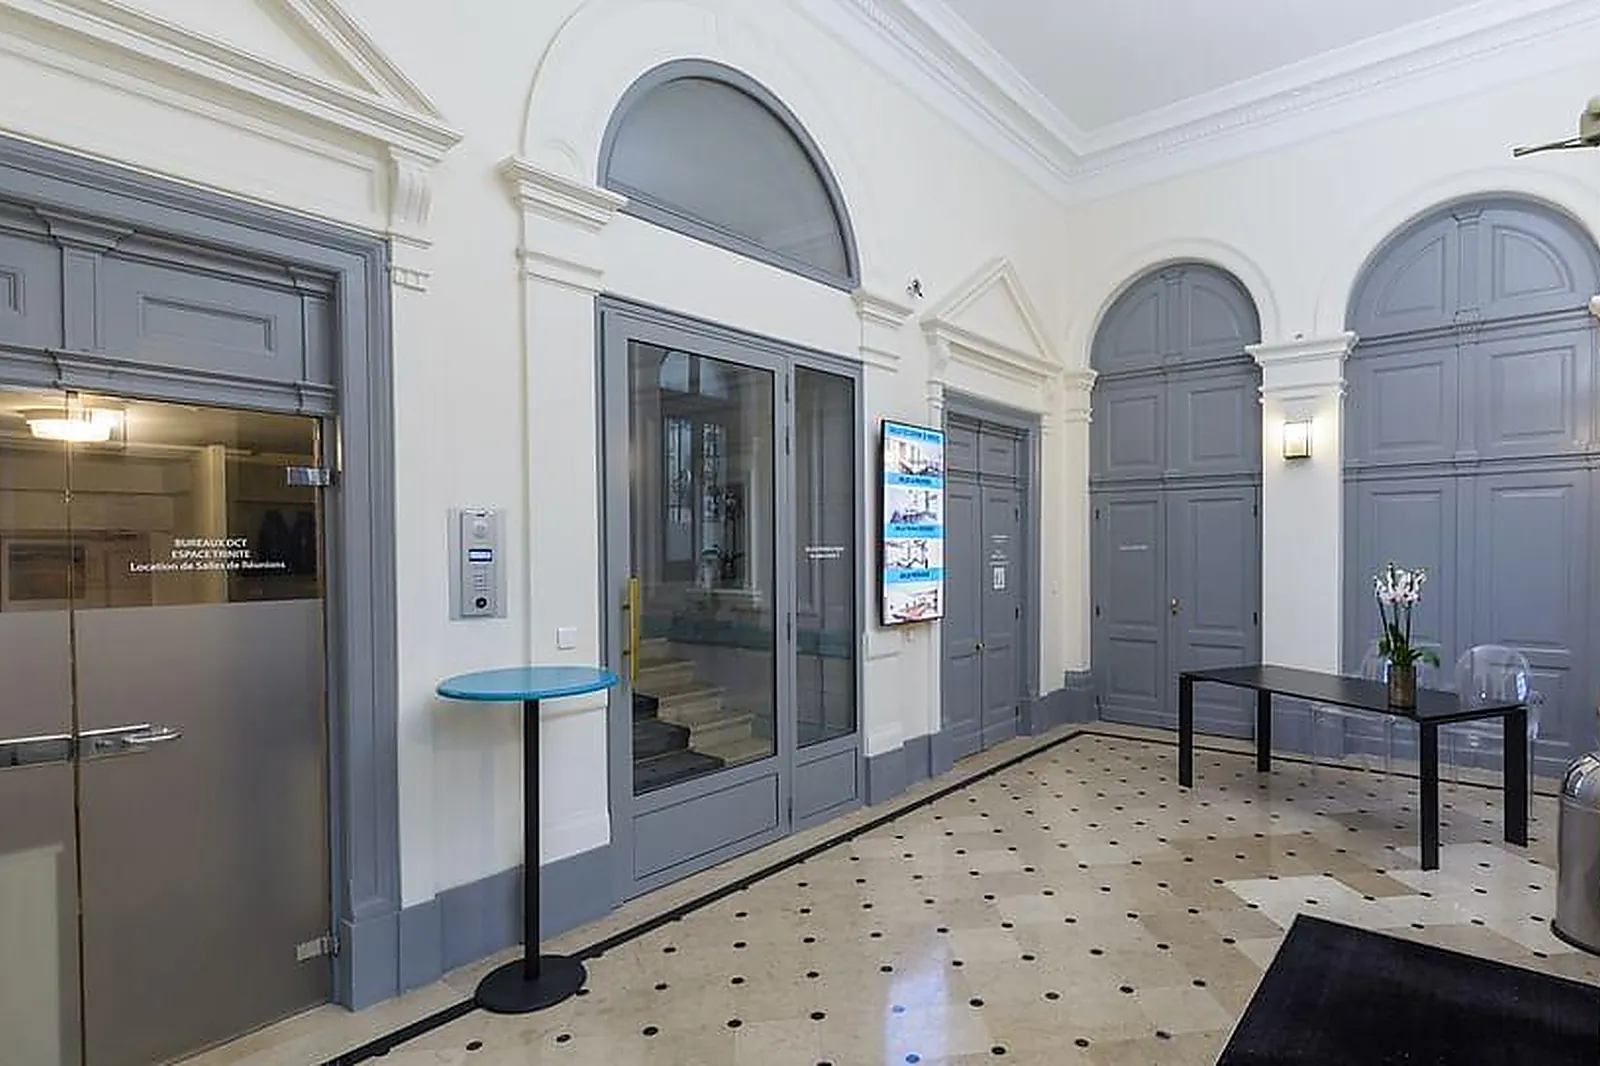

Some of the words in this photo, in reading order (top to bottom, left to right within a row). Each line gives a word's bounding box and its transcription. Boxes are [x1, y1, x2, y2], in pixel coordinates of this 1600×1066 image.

[174, 538, 226, 548] BUREAUX
[171, 549, 210, 559] ESPACE
[130, 562, 179, 572] Location
[180, 561, 194, 571] de
[226, 560, 240, 570] de
